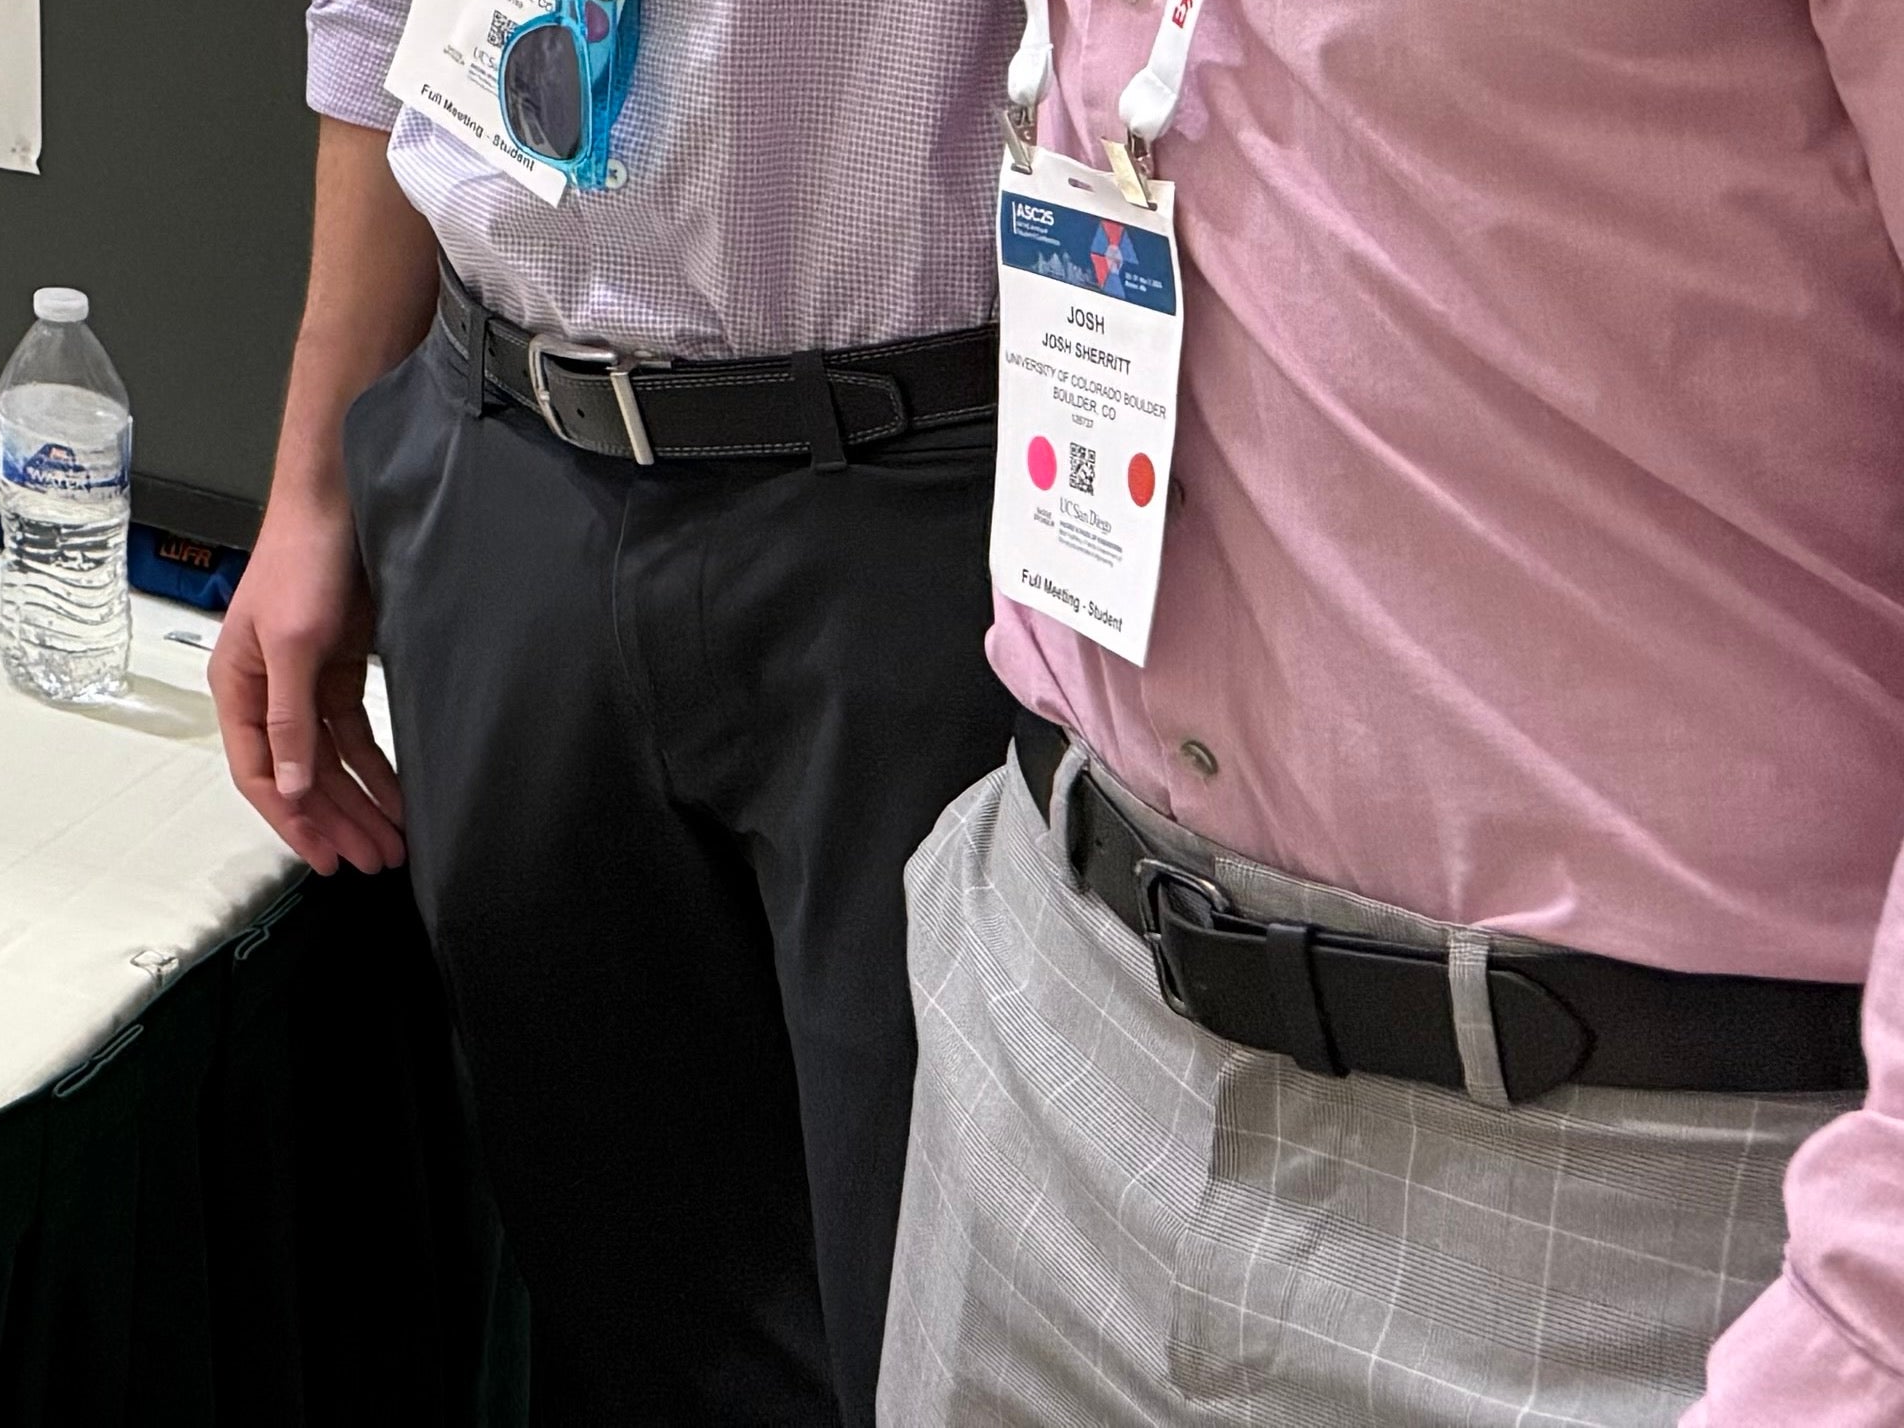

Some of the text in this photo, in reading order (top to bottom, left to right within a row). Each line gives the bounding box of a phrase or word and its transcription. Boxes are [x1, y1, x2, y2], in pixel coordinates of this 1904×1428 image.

[1067, 306, 1105, 334] JOSH
[1042, 332, 1131, 376] JOSH SHERRITT
[1005, 350, 1166, 419] UNIVERSITY OF COLORADO BOULDER
[1101, 404, 1116, 421] CO
[1022, 568, 1042, 589] Full
[1044, 577, 1080, 613] Meeting
[1088, 600, 1123, 632] Student
